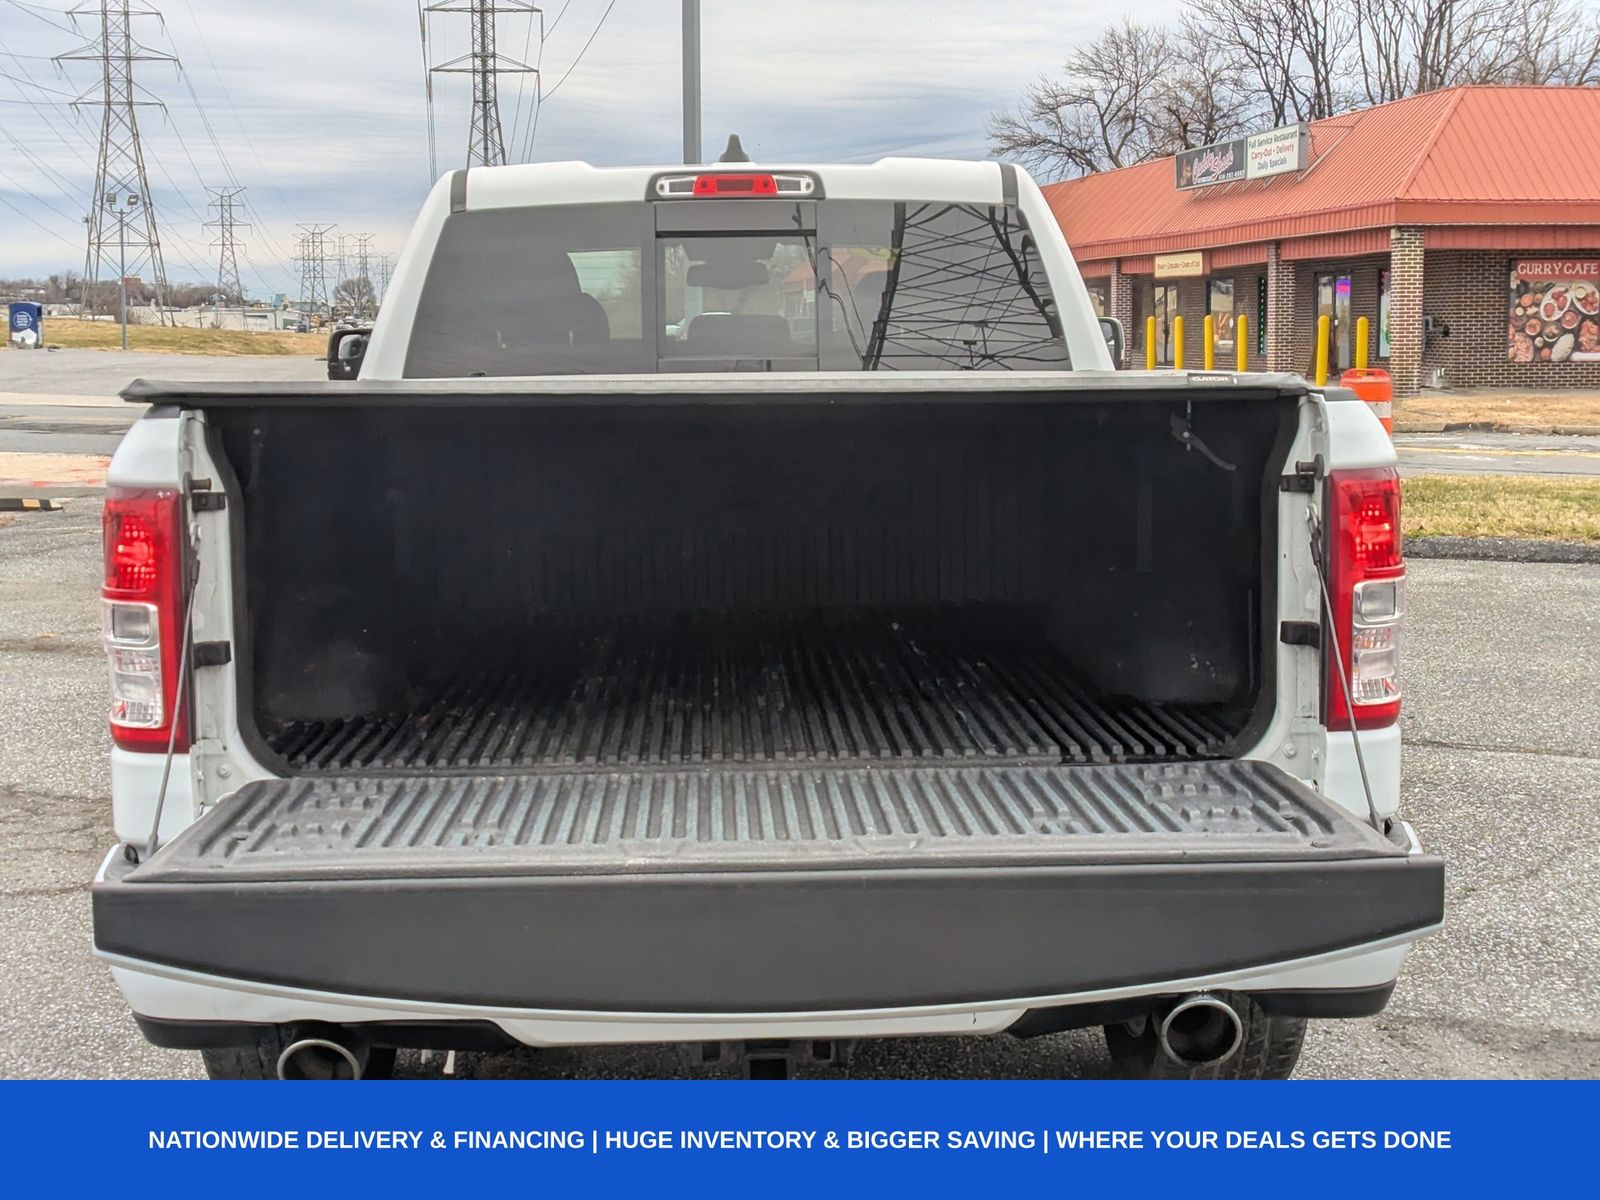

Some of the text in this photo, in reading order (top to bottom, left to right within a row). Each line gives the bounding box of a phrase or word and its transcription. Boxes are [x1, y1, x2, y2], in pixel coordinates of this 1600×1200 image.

[1249, 130, 1298, 149] Full Service Restaurant
[1276, 143, 1295, 154] Delivery
[1258, 156, 1287, 170] Daily Specials
